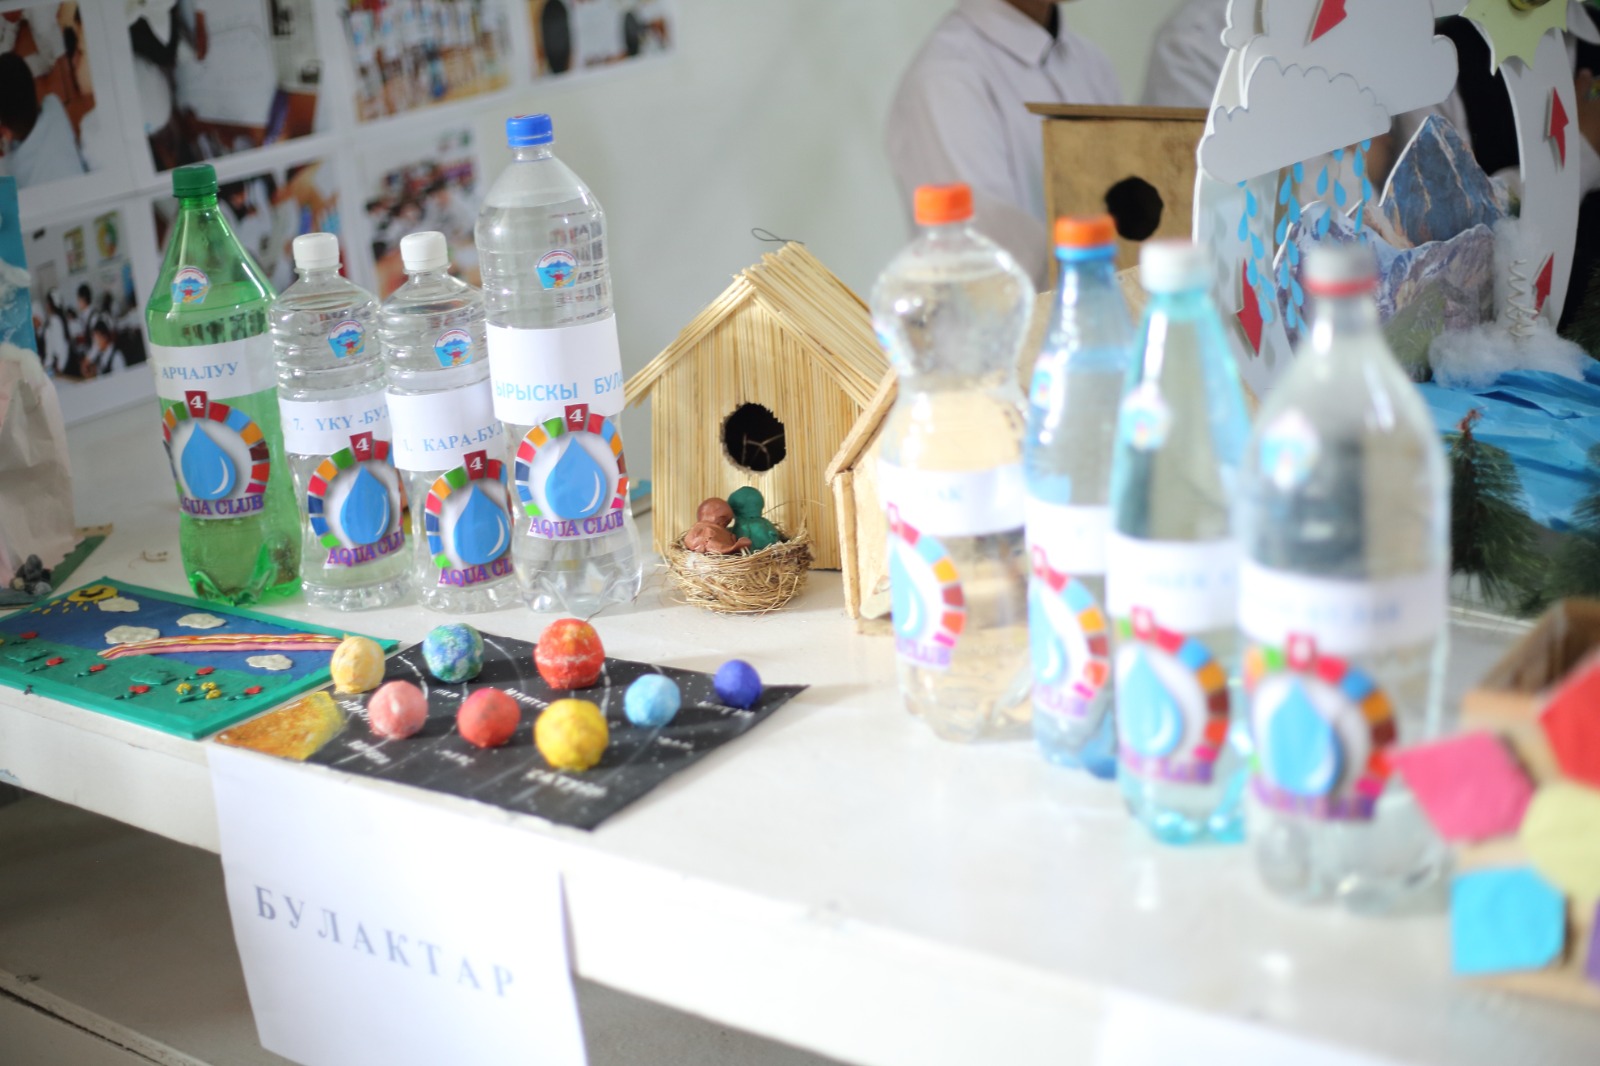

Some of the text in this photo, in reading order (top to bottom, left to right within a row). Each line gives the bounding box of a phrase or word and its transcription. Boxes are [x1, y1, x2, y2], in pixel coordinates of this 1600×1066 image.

[161, 362, 239, 380] АРЧАЛУУ
[496, 380, 579, 401] ЫРЫСКЫ
[190, 395, 204, 409] 4
[569, 408, 585, 423] 4
[356, 438, 370, 452] 4
[469, 456, 484, 471] 4
[215, 494, 264, 515] CLUB
[529, 510, 624, 540] AQUA CLUB
[327, 543, 377, 568] AQUA
[439, 565, 490, 588] AQUA
[254, 884, 514, 998] БУЛАКТАР
